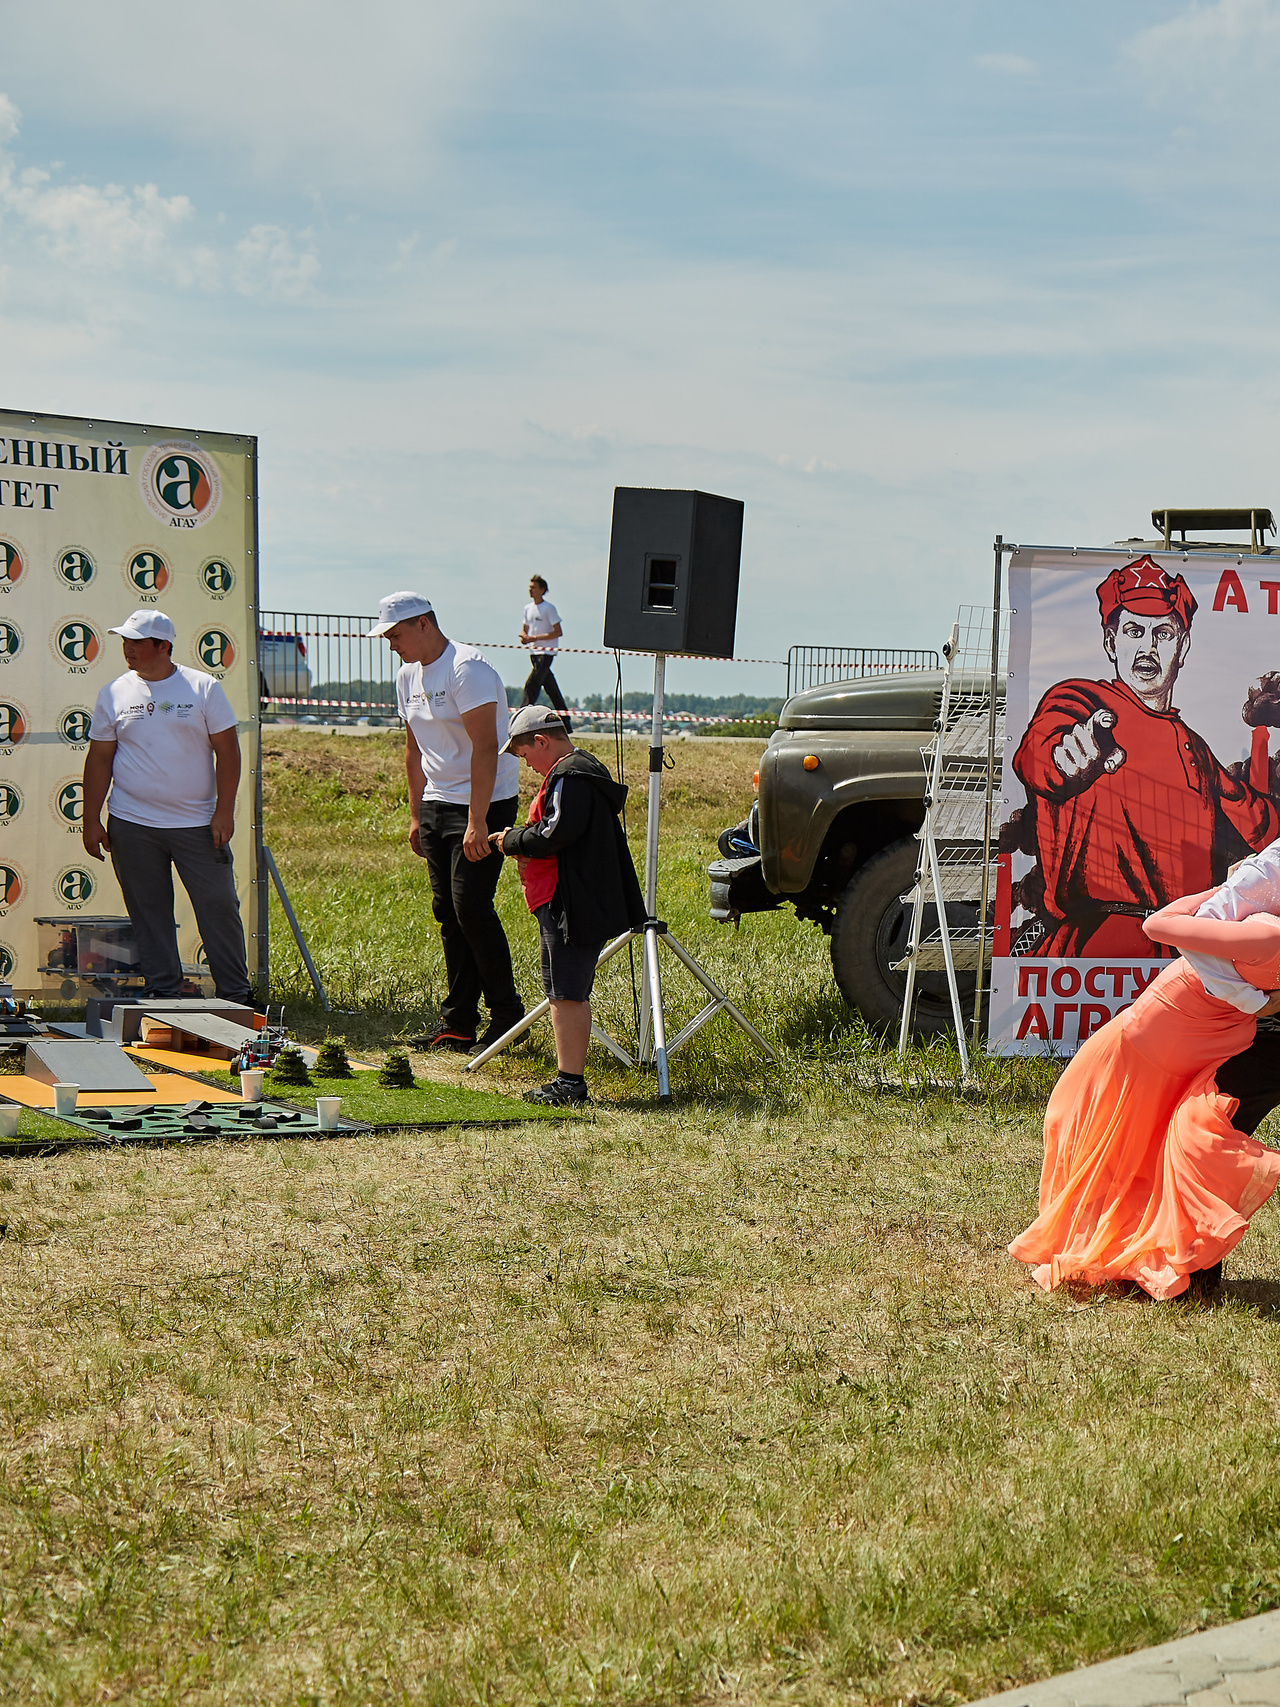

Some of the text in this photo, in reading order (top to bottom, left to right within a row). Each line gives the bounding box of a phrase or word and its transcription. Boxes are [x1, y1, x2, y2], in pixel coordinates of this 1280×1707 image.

[169, 517, 198, 528] АГАУ
[1213, 569, 1249, 613] А
[139, 595, 159, 603] АГАУ
[68, 667, 89, 675] АГАУ
[66, 826, 84, 834] АГА
[1018, 966, 1165, 1000] ПОСТУ
